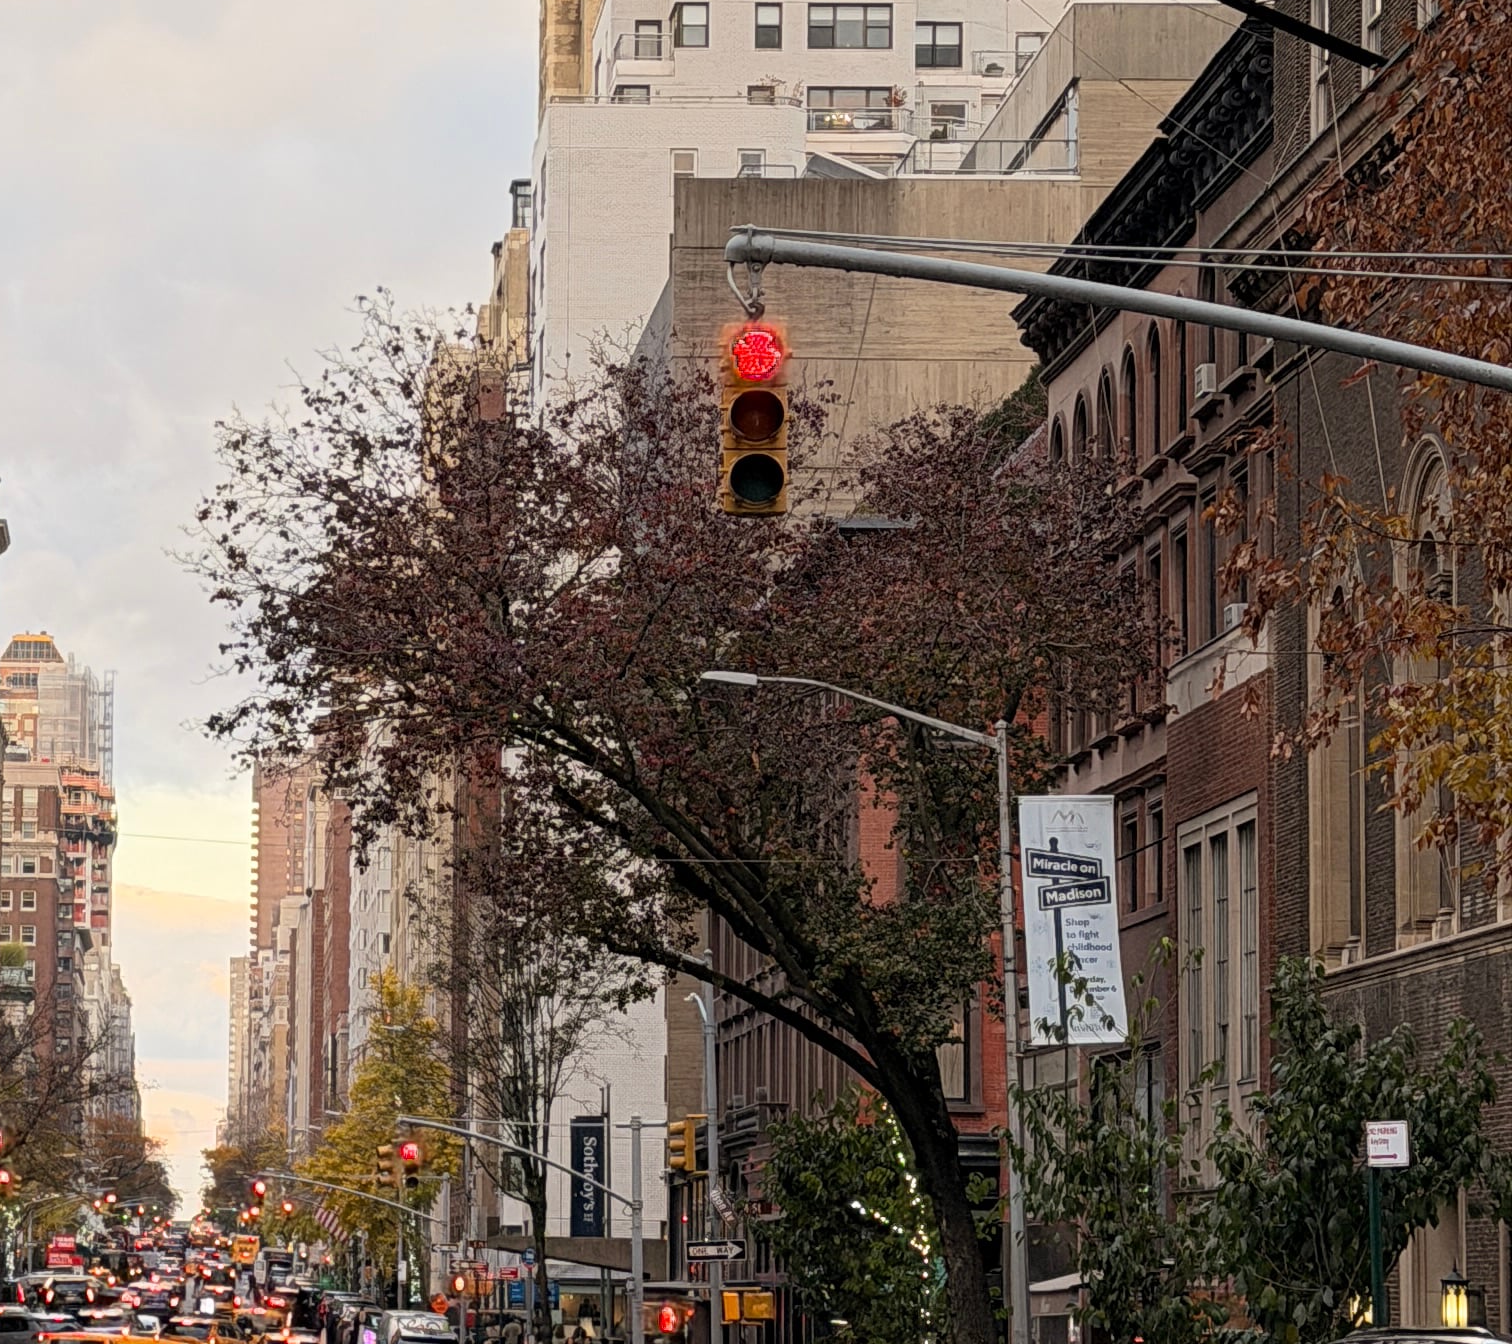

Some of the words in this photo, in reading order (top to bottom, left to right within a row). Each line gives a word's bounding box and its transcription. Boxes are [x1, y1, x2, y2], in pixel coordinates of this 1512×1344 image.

[1032, 857, 1078, 872] Miracle
[1079, 864, 1096, 874] on
[1045, 887, 1102, 904] Madison
[1065, 918, 1090, 928] Shop
[1066, 931, 1076, 939] to
[1078, 930, 1099, 940] fight
[1067, 943, 1112, 951] childhood
[1069, 985, 1110, 993] Dmber
[692, 1247, 707, 1256] ONE
